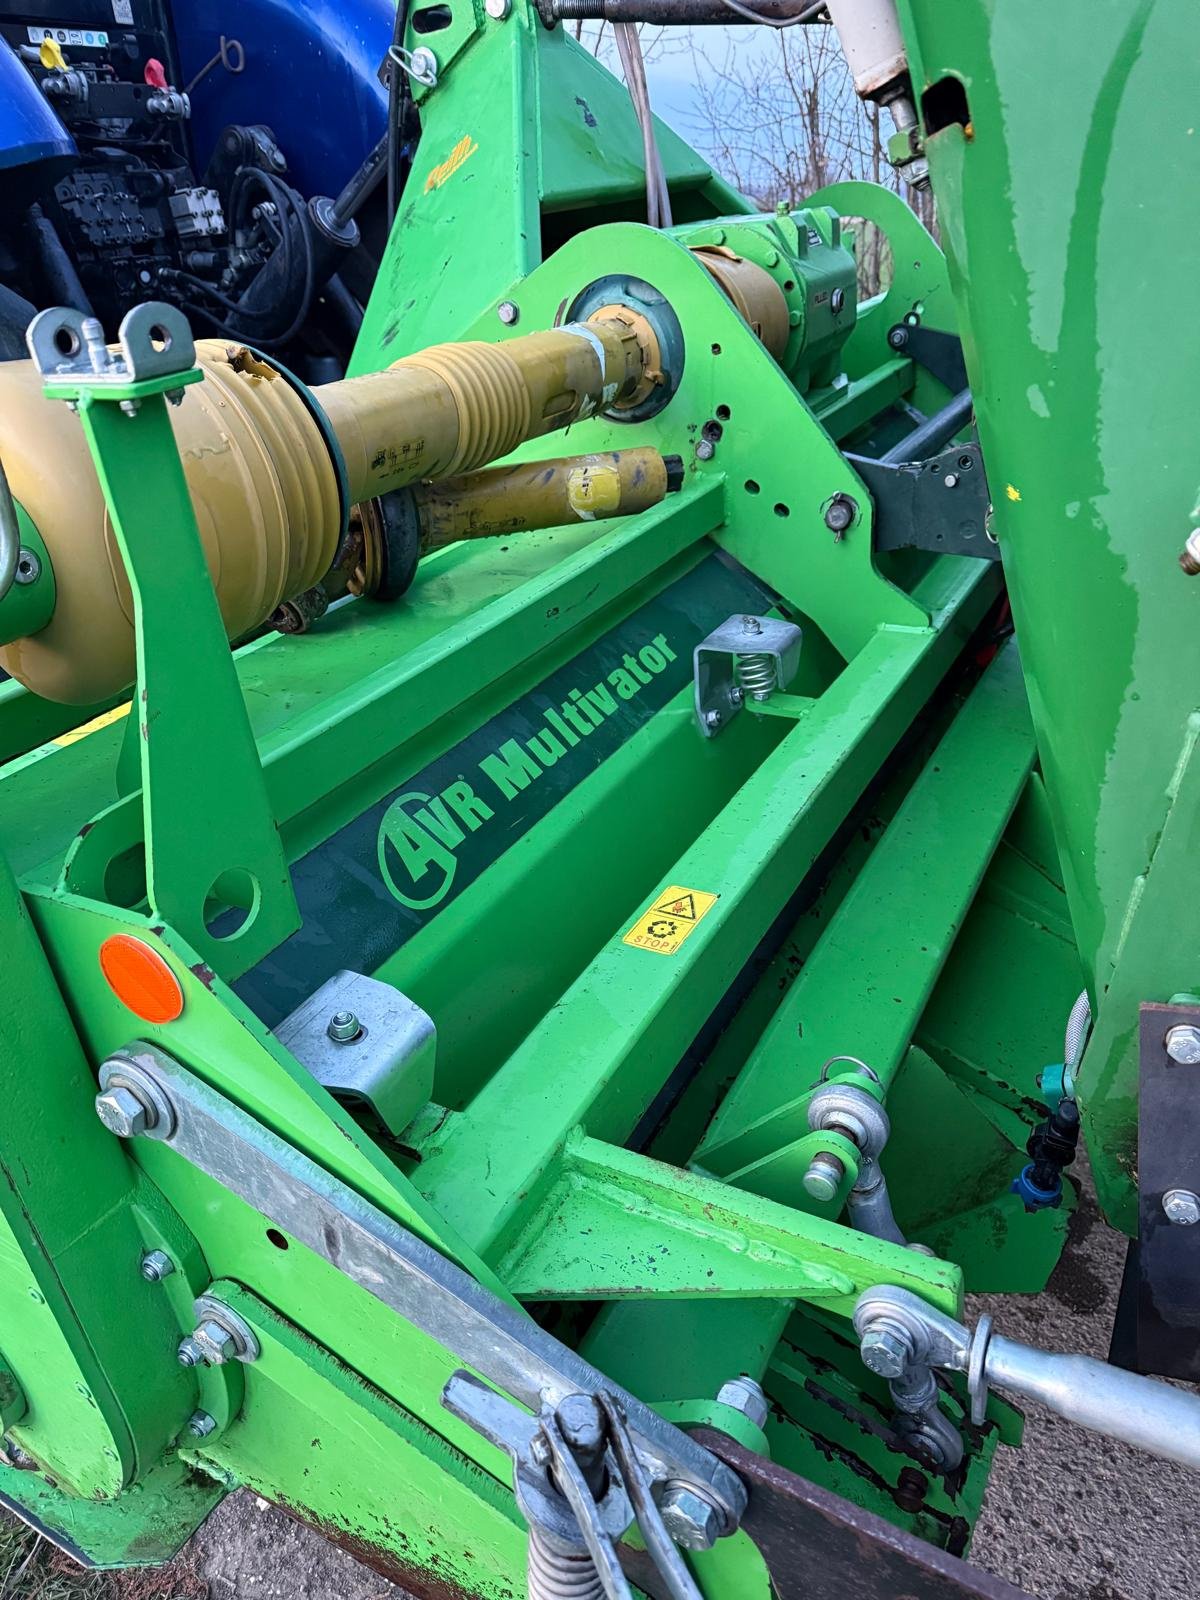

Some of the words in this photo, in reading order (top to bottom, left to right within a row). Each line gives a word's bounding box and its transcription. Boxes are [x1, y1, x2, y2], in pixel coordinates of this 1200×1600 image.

[377, 780, 495, 910] AVR
[478, 633, 678, 801] Multivator
[634, 935, 669, 949] STOP
